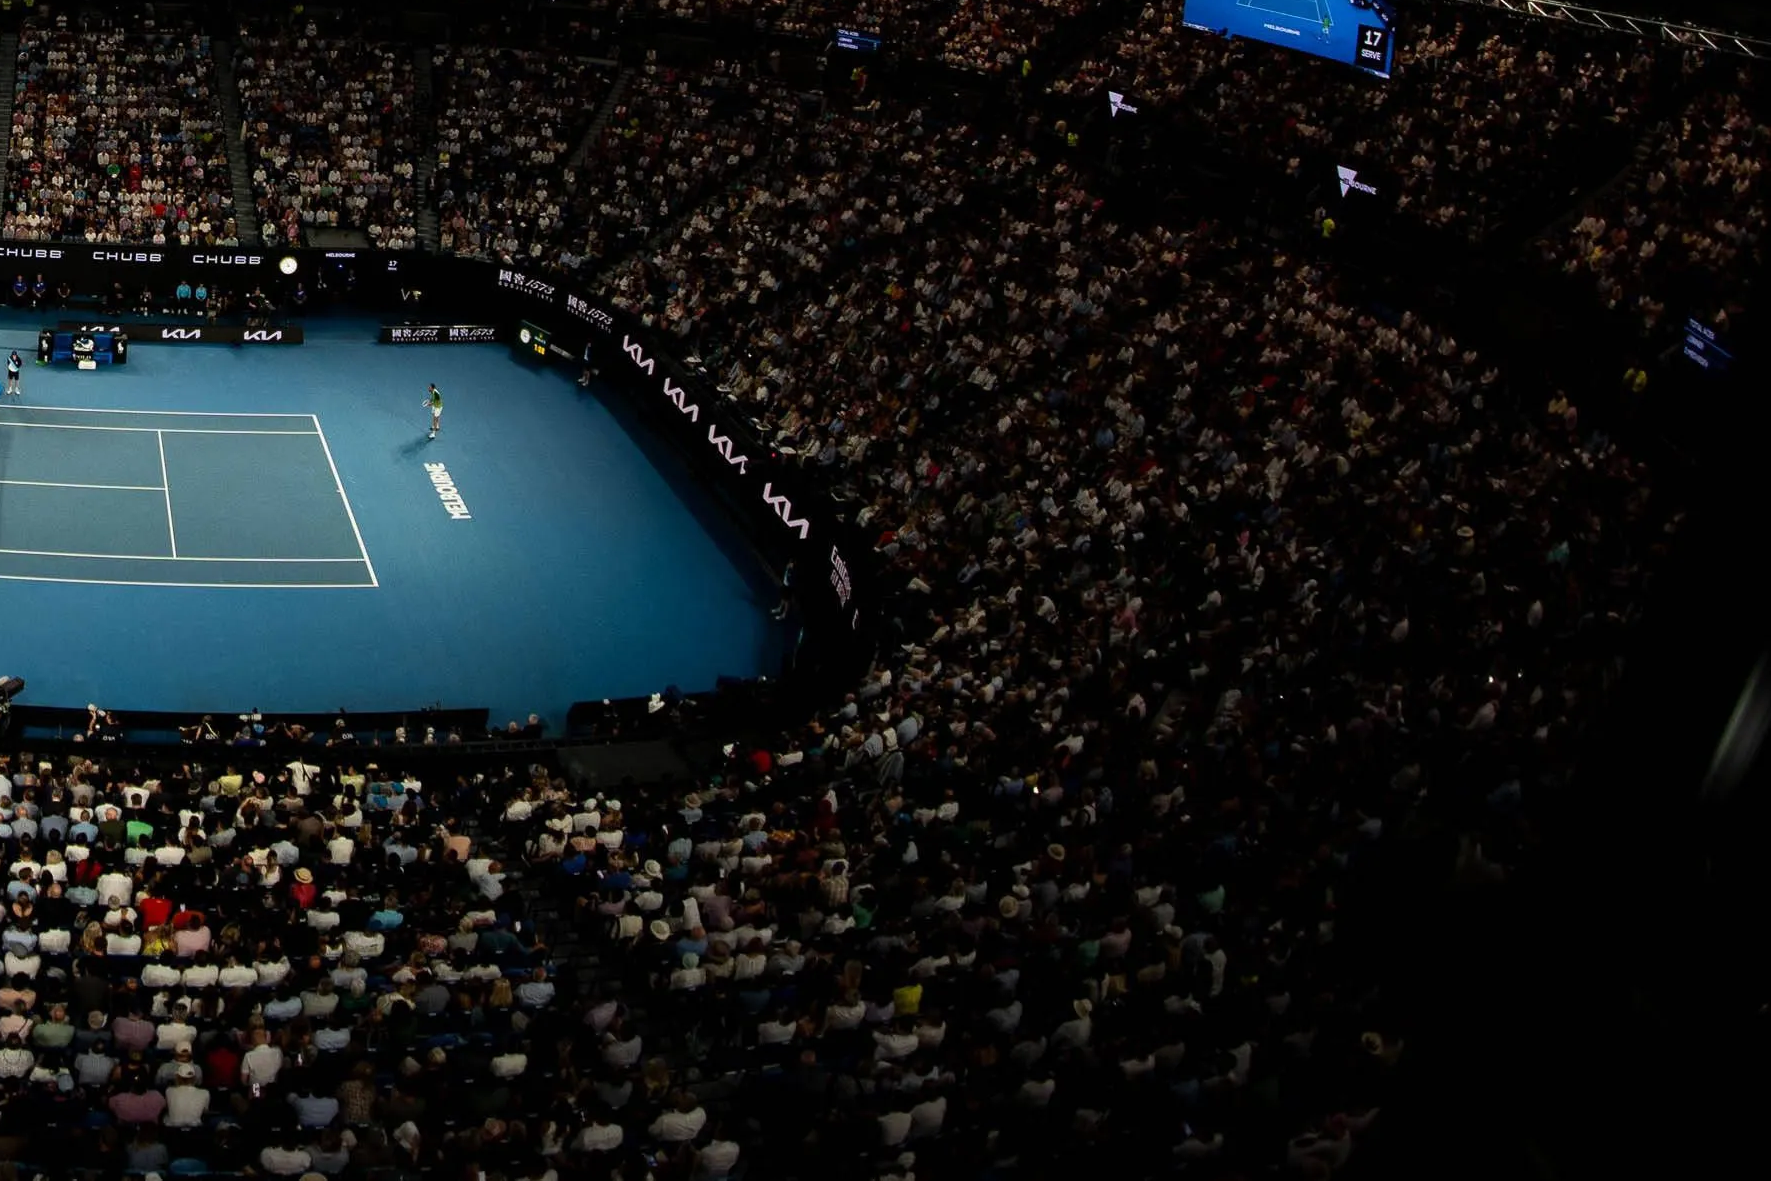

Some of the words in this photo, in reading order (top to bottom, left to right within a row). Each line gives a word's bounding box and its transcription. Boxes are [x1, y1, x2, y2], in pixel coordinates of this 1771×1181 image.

[1361, 48, 1382, 61] SERVE
[1364, 30, 1382, 47] 17
[93, 251, 163, 262] CHUBB
[192, 255, 262, 265] CHUBB
[162, 328, 201, 339] KIA
[243, 330, 282, 341] KIA
[623, 335, 655, 375] KIA
[663, 377, 699, 422] KIA
[708, 424, 749, 475] KIA
[424, 463, 472, 520] MELBOURNE
[763, 482, 809, 539] KIA
